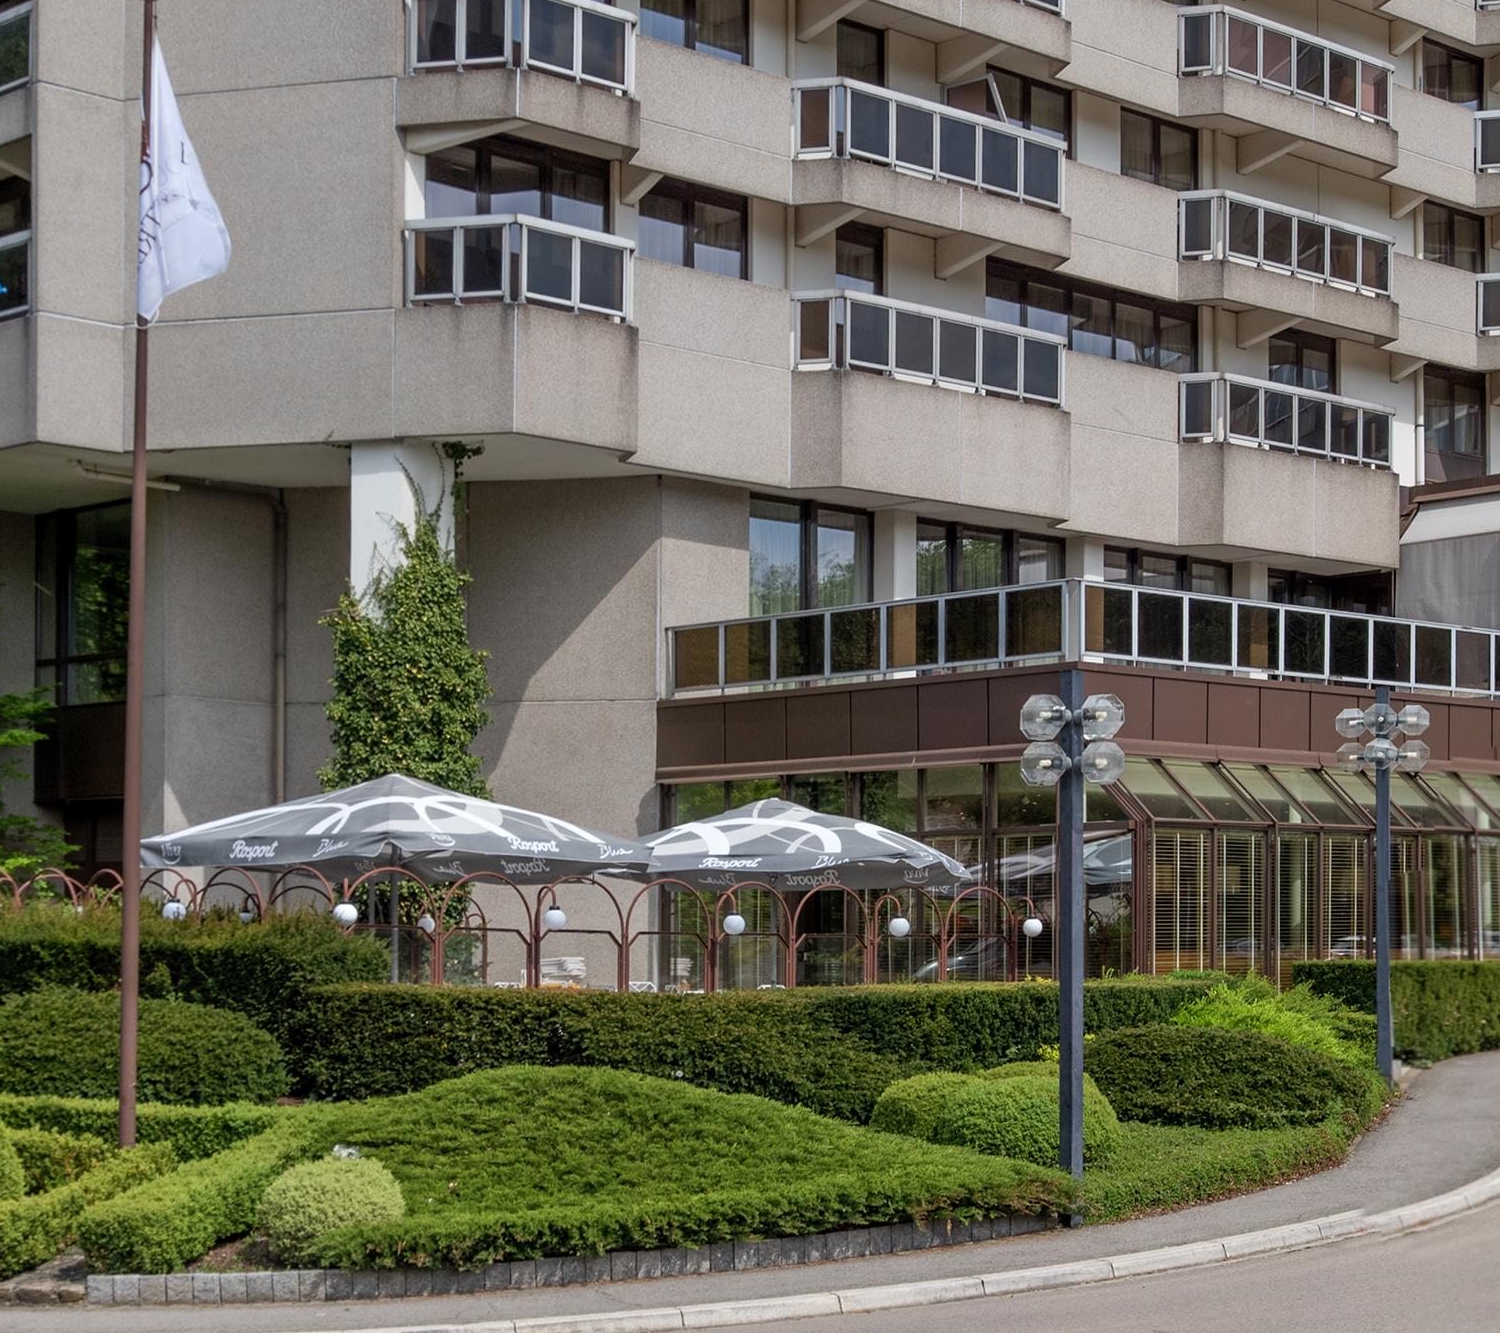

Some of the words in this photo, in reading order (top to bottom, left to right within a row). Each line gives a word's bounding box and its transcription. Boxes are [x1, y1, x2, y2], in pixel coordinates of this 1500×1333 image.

[229, 840, 279, 861] Rosport
[312, 839, 349, 858] Blue
[508, 836, 560, 853] Rosport
[597, 843, 634, 859] Blue
[698, 857, 763, 869] Rosport
